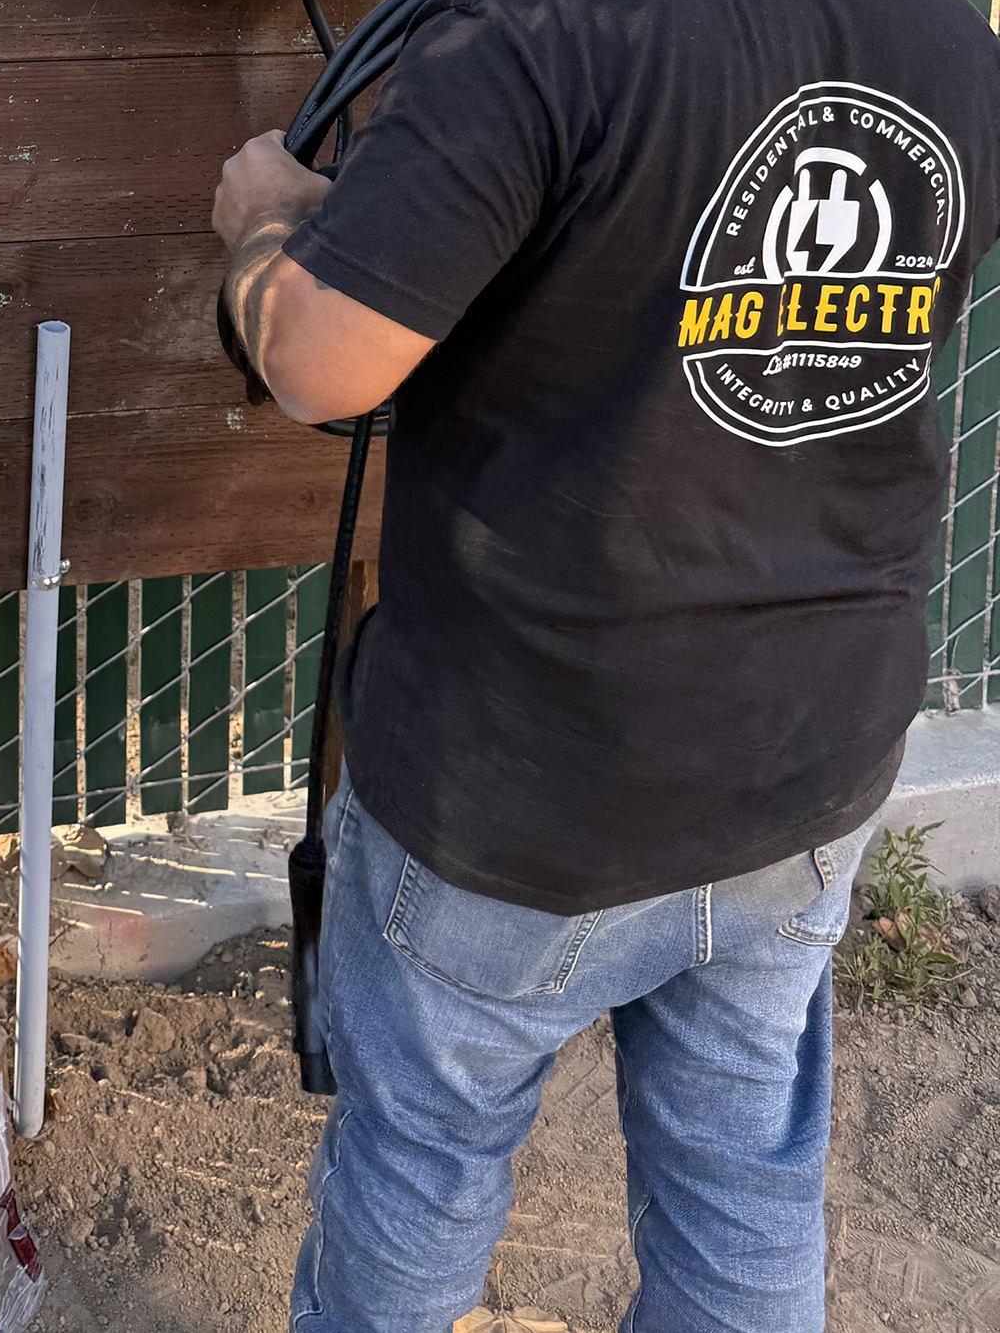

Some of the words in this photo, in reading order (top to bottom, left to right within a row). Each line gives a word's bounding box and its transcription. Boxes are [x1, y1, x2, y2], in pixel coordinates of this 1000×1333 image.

[725, 109, 818, 237] RESIDENTAL
[822, 106, 835, 123] &
[849, 108, 946, 226] COMMERCIAL
[894, 254, 934, 268] 2024
[677, 291, 764, 348] MAG
[777, 276, 941, 337] LECTR
[715, 362, 795, 417] INTEGRITY
[801, 398, 813, 413] &
[824, 357, 921, 411] QUALITY
